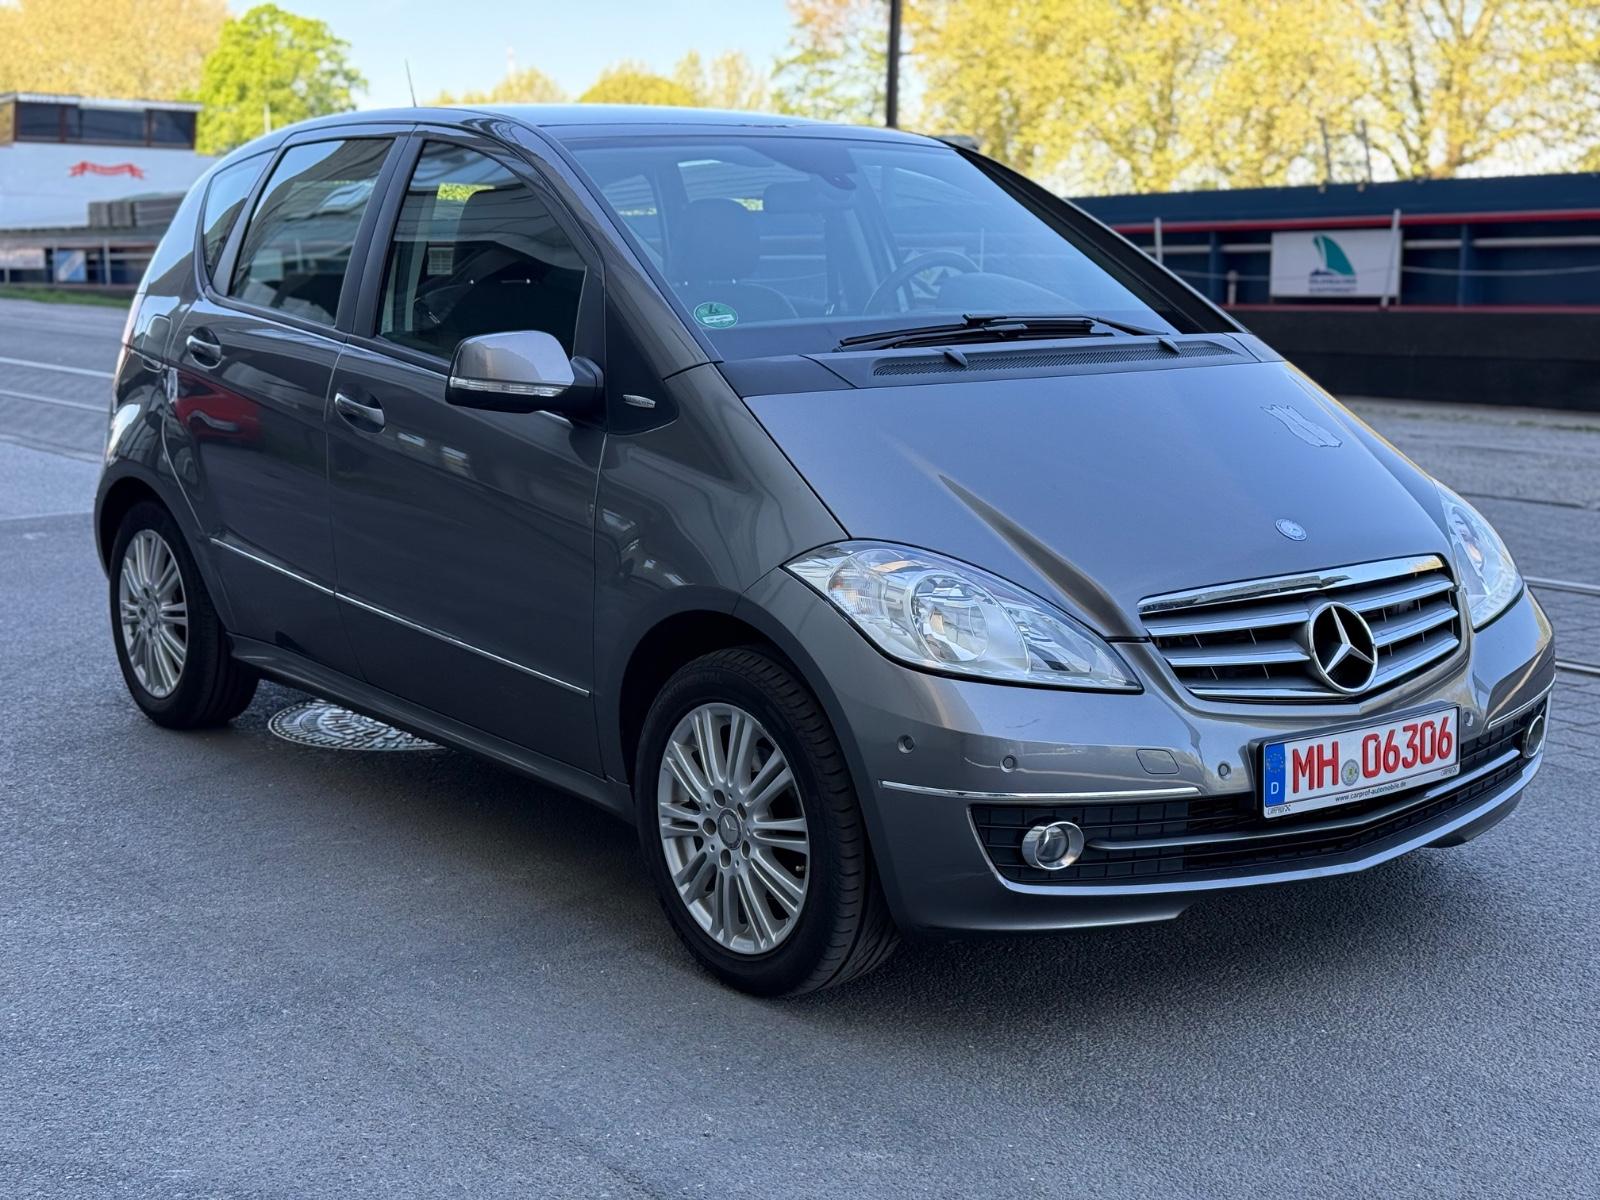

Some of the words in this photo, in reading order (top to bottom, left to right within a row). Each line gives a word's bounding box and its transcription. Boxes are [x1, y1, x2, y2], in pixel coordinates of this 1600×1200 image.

[1292, 741, 1339, 794] MH
[1362, 716, 1453, 779] 06306
[1270, 781, 1279, 795] D
[1335, 781, 1407, 802] www.carprof-automobile.de
